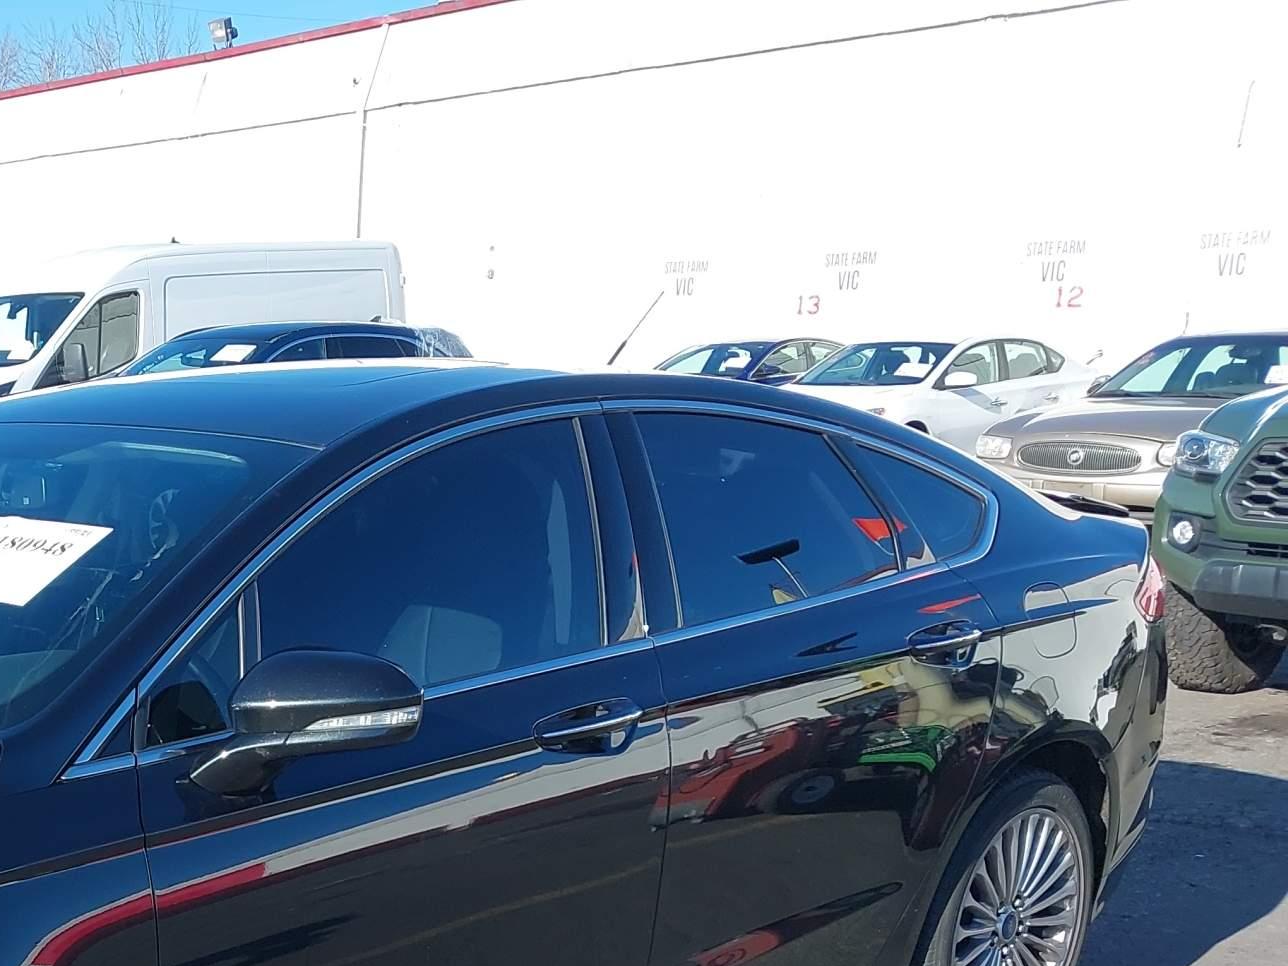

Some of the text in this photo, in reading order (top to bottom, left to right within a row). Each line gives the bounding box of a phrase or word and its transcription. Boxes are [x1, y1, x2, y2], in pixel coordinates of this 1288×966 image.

[1027, 240, 1086, 256] STATE FARM
[1201, 230, 1271, 250] STATE FARM
[665, 260, 709, 274] STATE FARM
[825, 251, 877, 267] STATE FARM
[1218, 253, 1246, 276] VIC
[839, 270, 859, 290] VIC
[1042, 260, 1065, 282] VIC
[676, 277, 694, 296] VIC
[797, 295, 820, 315] 13
[1056, 286, 1083, 308] 12
